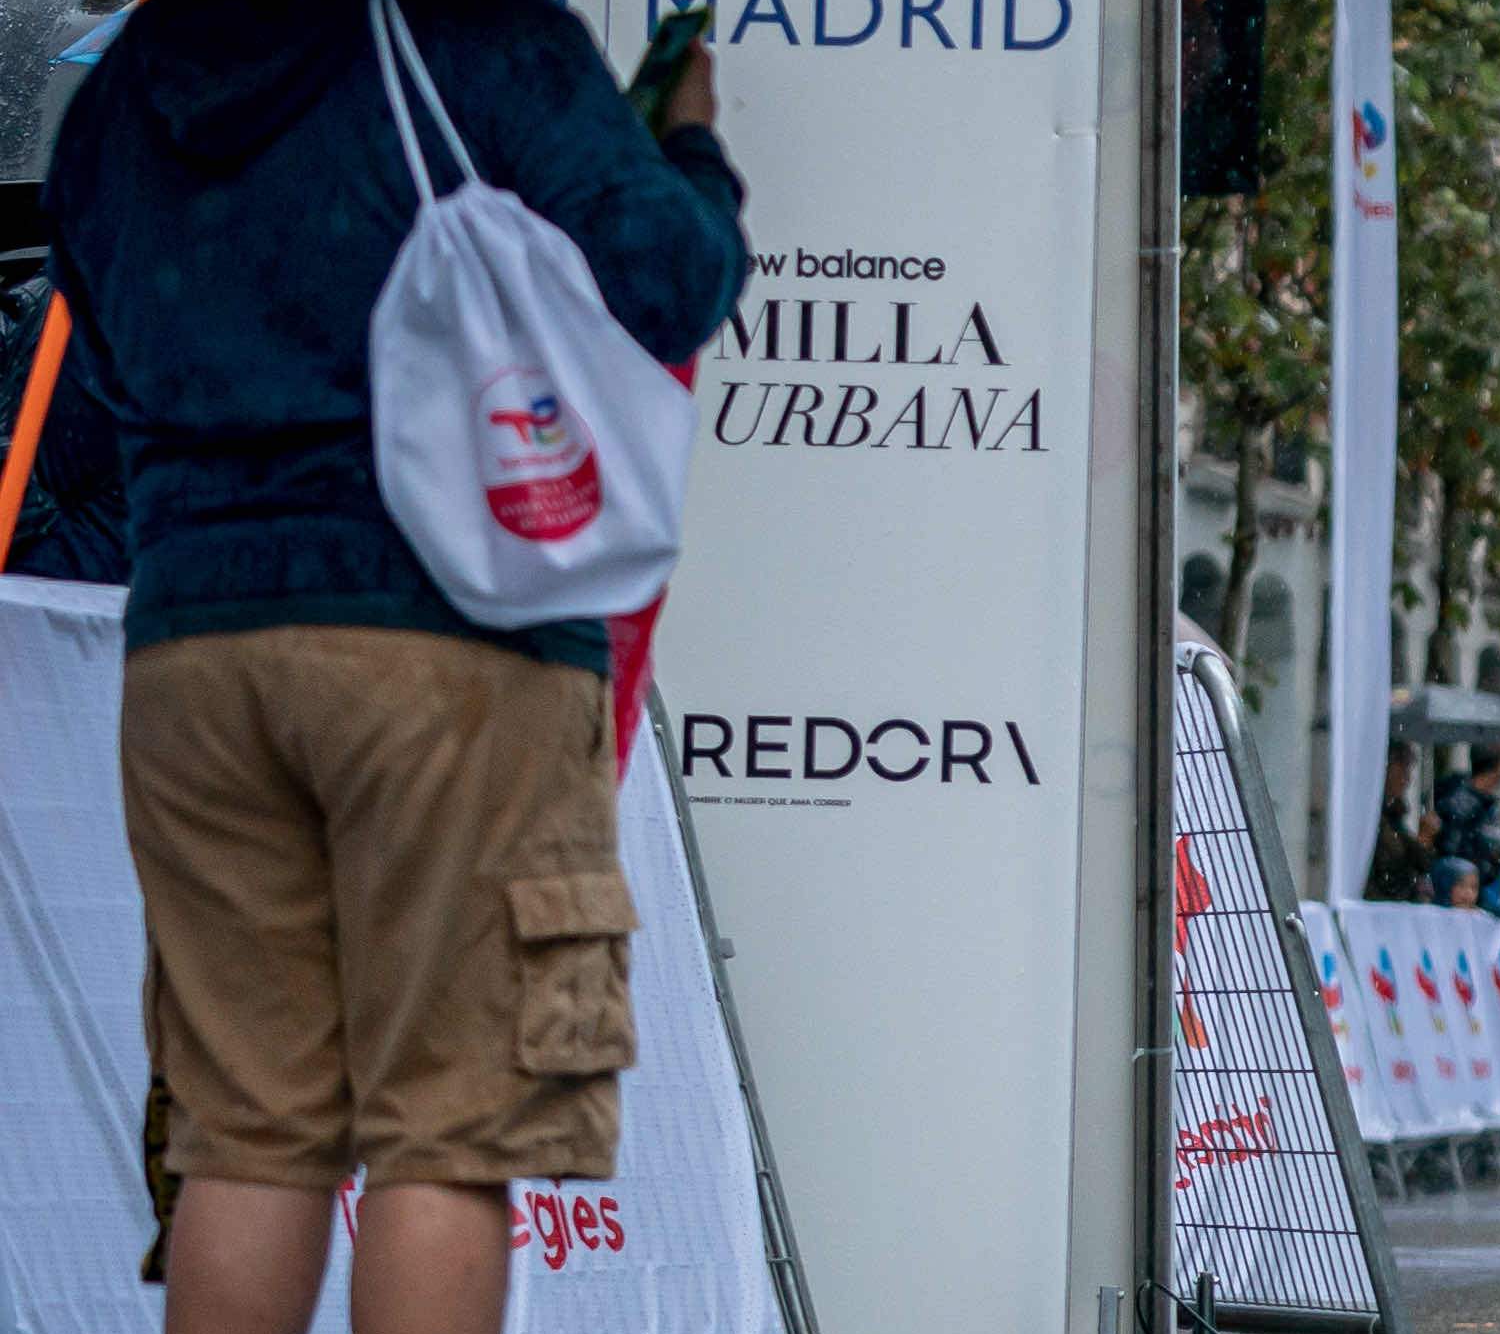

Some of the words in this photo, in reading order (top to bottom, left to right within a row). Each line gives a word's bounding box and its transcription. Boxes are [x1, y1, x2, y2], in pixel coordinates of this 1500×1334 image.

[796, 248, 946, 281] balance
[713, 298, 1012, 366] MILLA
[714, 381, 1050, 452] URBANA
[688, 795, 721, 804] OMBRE
